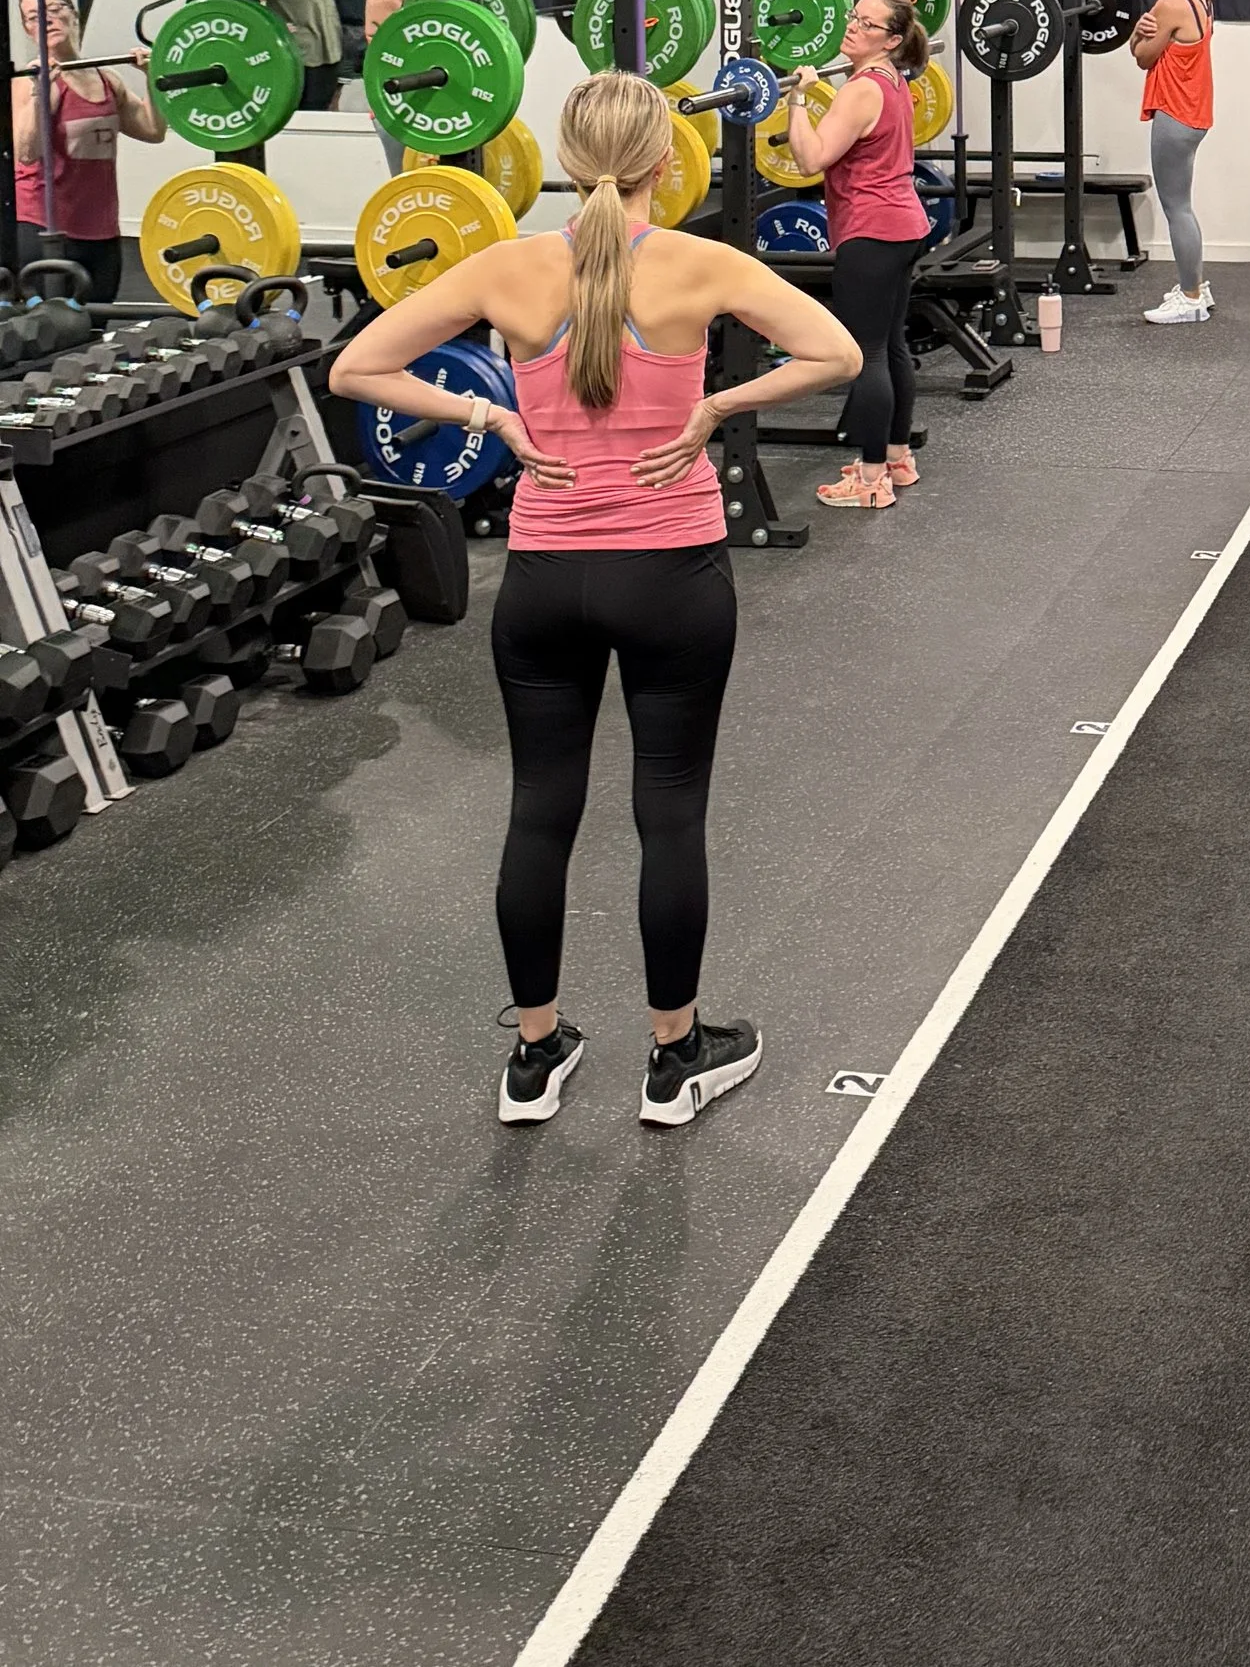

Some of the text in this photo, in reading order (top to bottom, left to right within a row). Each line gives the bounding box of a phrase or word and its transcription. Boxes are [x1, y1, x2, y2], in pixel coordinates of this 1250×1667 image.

[402, 20, 493, 68] ROGUE
[791, 6, 835, 58] ROGUE
[1081, 25, 1118, 42] ROG
[380, 52, 404, 68] 25LB
[383, 87, 473, 134] ROGUE
[471, 87, 494, 102] 25LB
[753, 71, 770, 113] ROGUE
[919, 76, 937, 123] OGUE
[372, 192, 453, 245] ROGUE
[795, 218, 830, 252] ROG
[376, 406, 402, 464] ROG
[412, 462, 426, 485] 45LB
[1075, 723, 1111, 733] 2
[834, 1075, 885, 1094] 2
